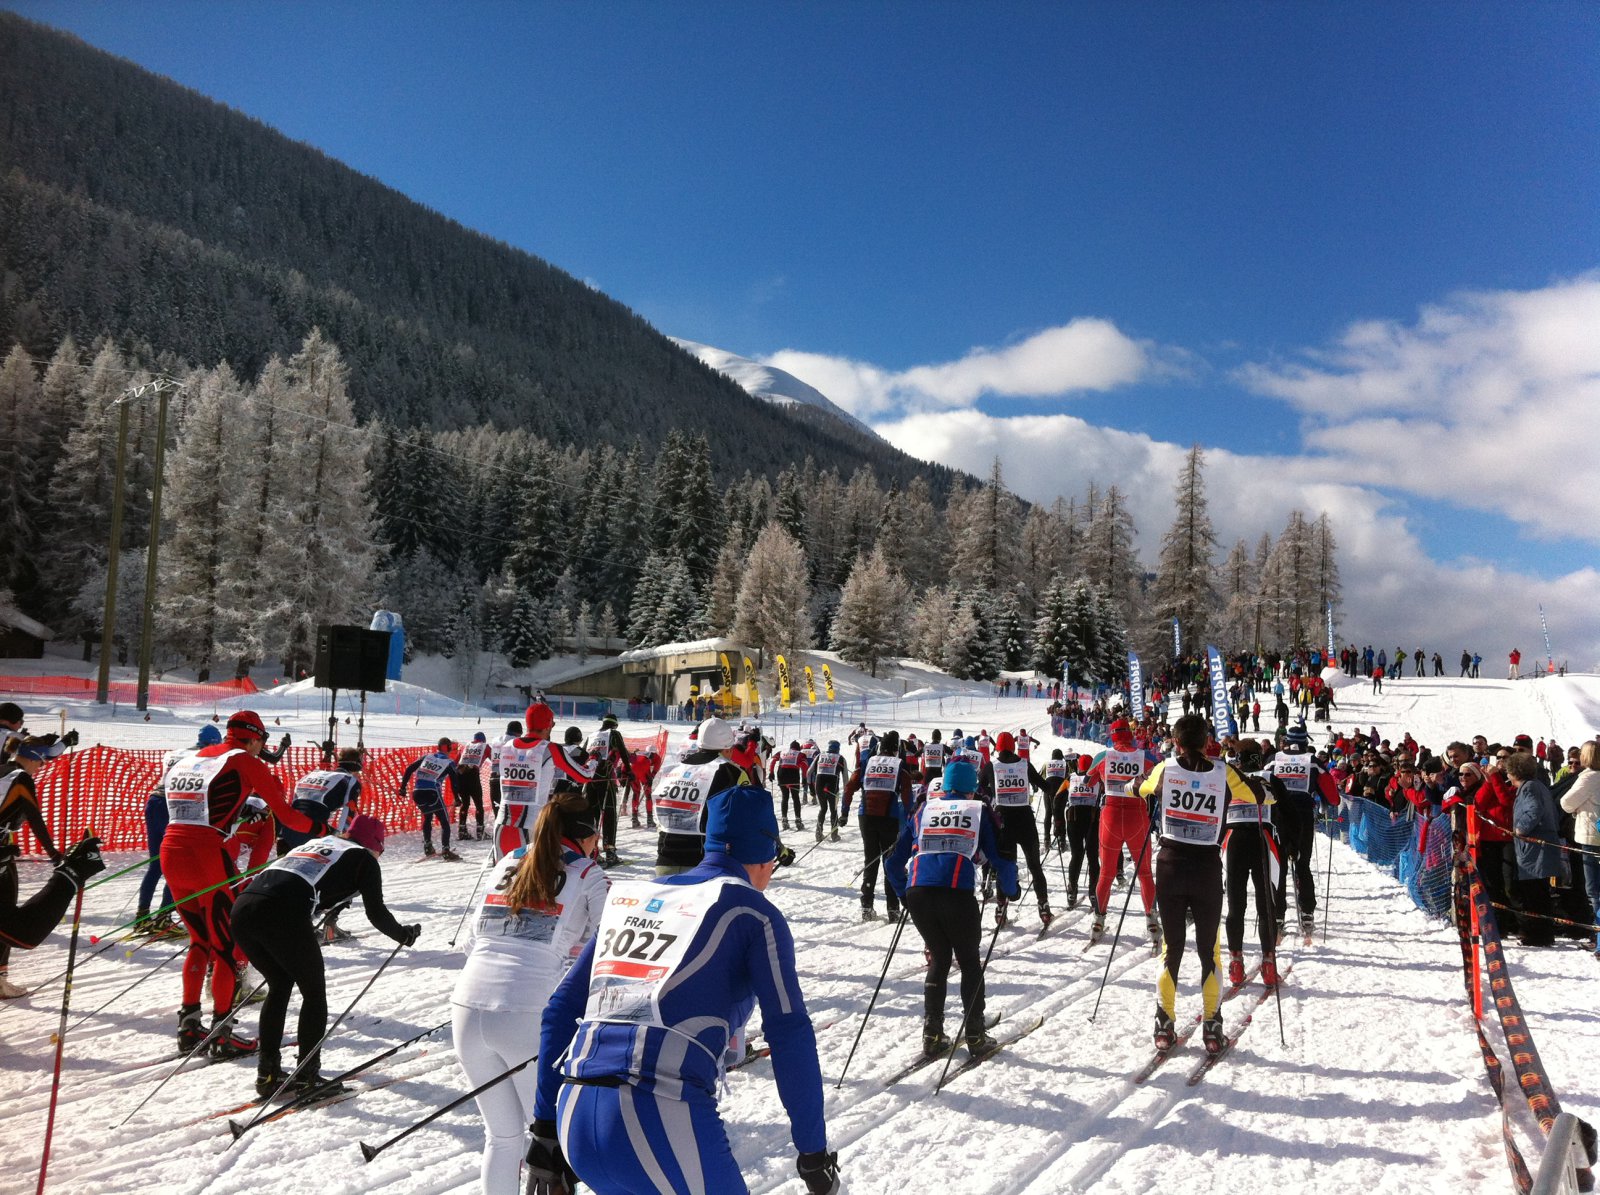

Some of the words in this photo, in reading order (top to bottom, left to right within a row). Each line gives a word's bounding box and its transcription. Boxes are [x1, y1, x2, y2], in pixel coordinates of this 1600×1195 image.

[422, 761, 442, 772] 3607
[870, 766, 894, 774] 3033
[1110, 762, 1139, 775] 3609
[1279, 766, 1305, 774] 3042
[504, 768, 535, 780] 3006
[169, 777, 204, 791] 3059
[999, 779, 1025, 787] 3040
[659, 785, 700, 801] 3010
[1170, 789, 1217, 814] 3074
[929, 816, 972, 828] 3015
[611, 897, 640, 908] coop
[624, 916, 663, 930] FRANZ
[599, 928, 677, 962] 3027
